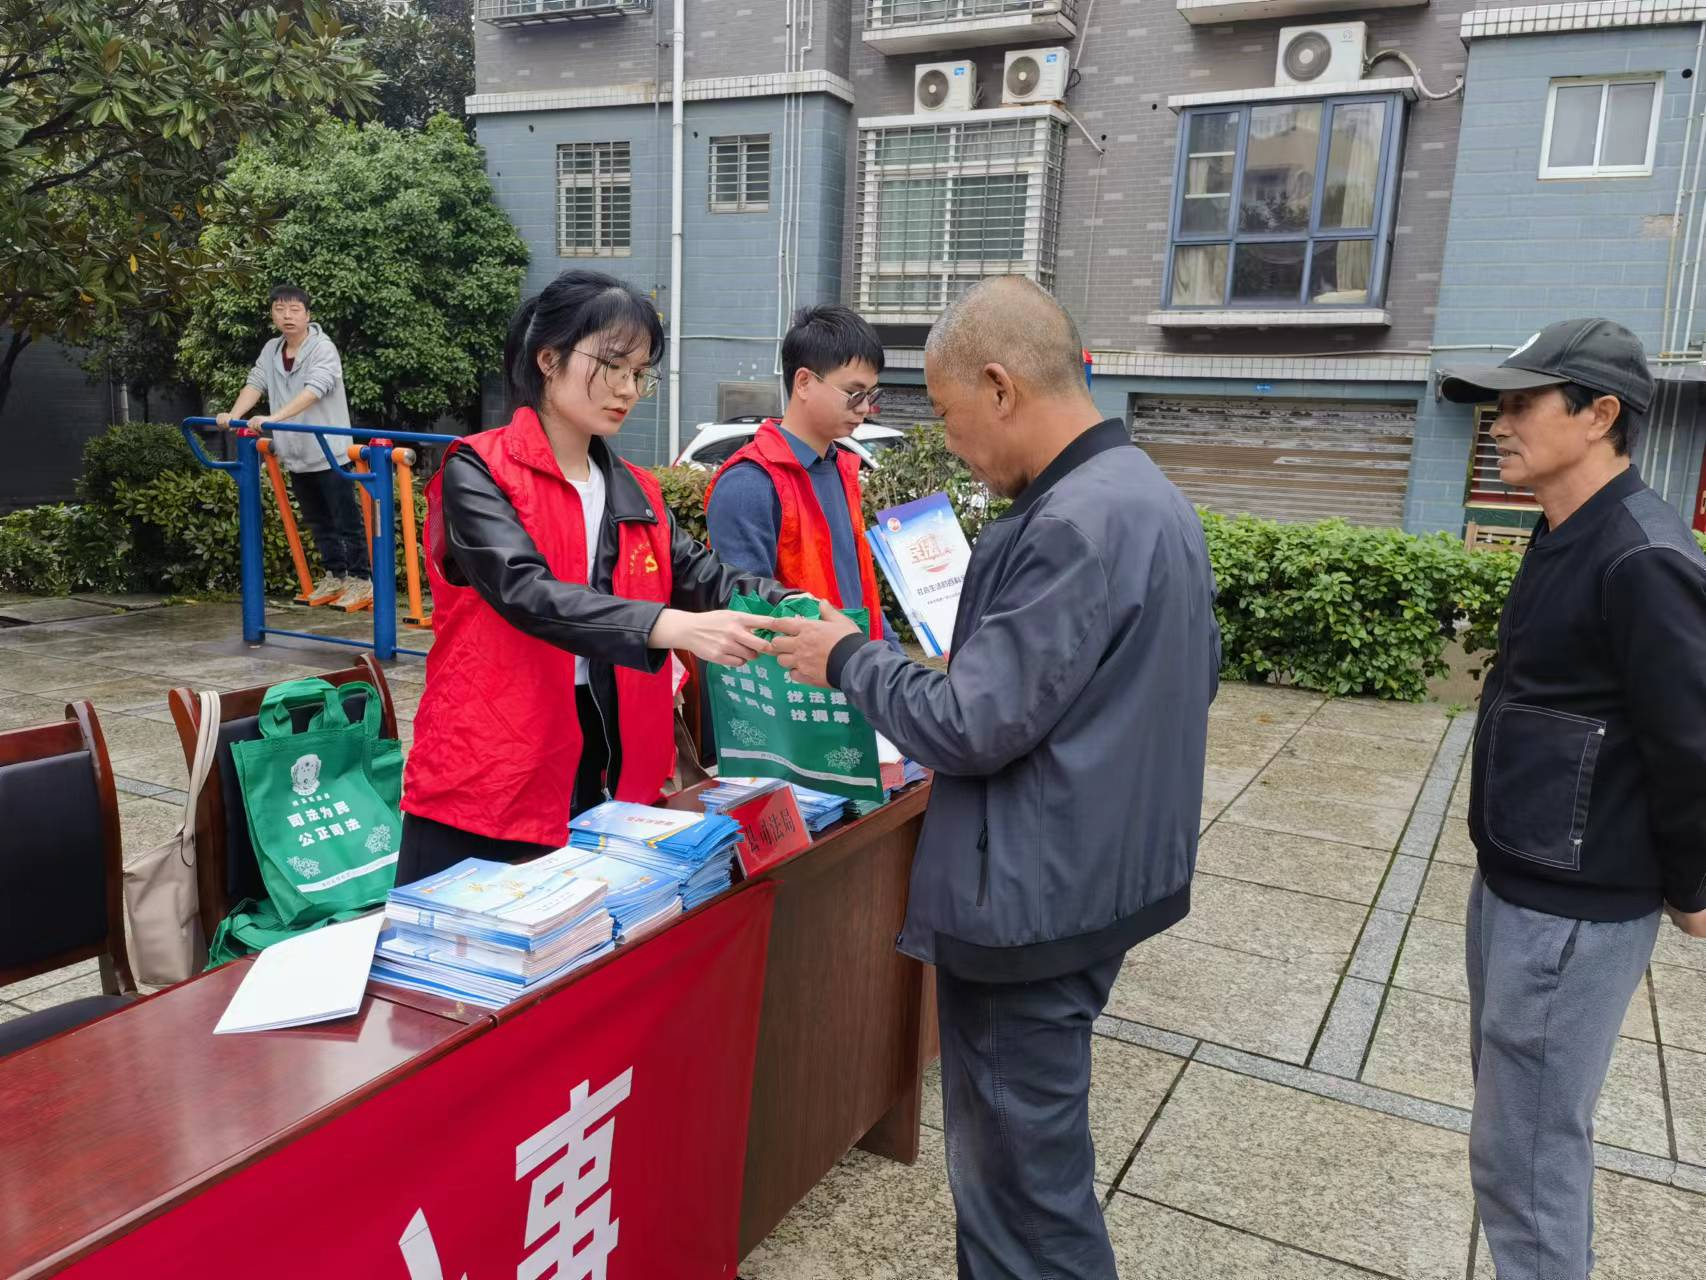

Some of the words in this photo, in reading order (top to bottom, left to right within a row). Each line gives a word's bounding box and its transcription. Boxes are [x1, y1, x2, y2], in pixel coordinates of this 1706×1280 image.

[287, 801, 350, 827] 司法为民
[299, 818, 361, 847] 公正司法
